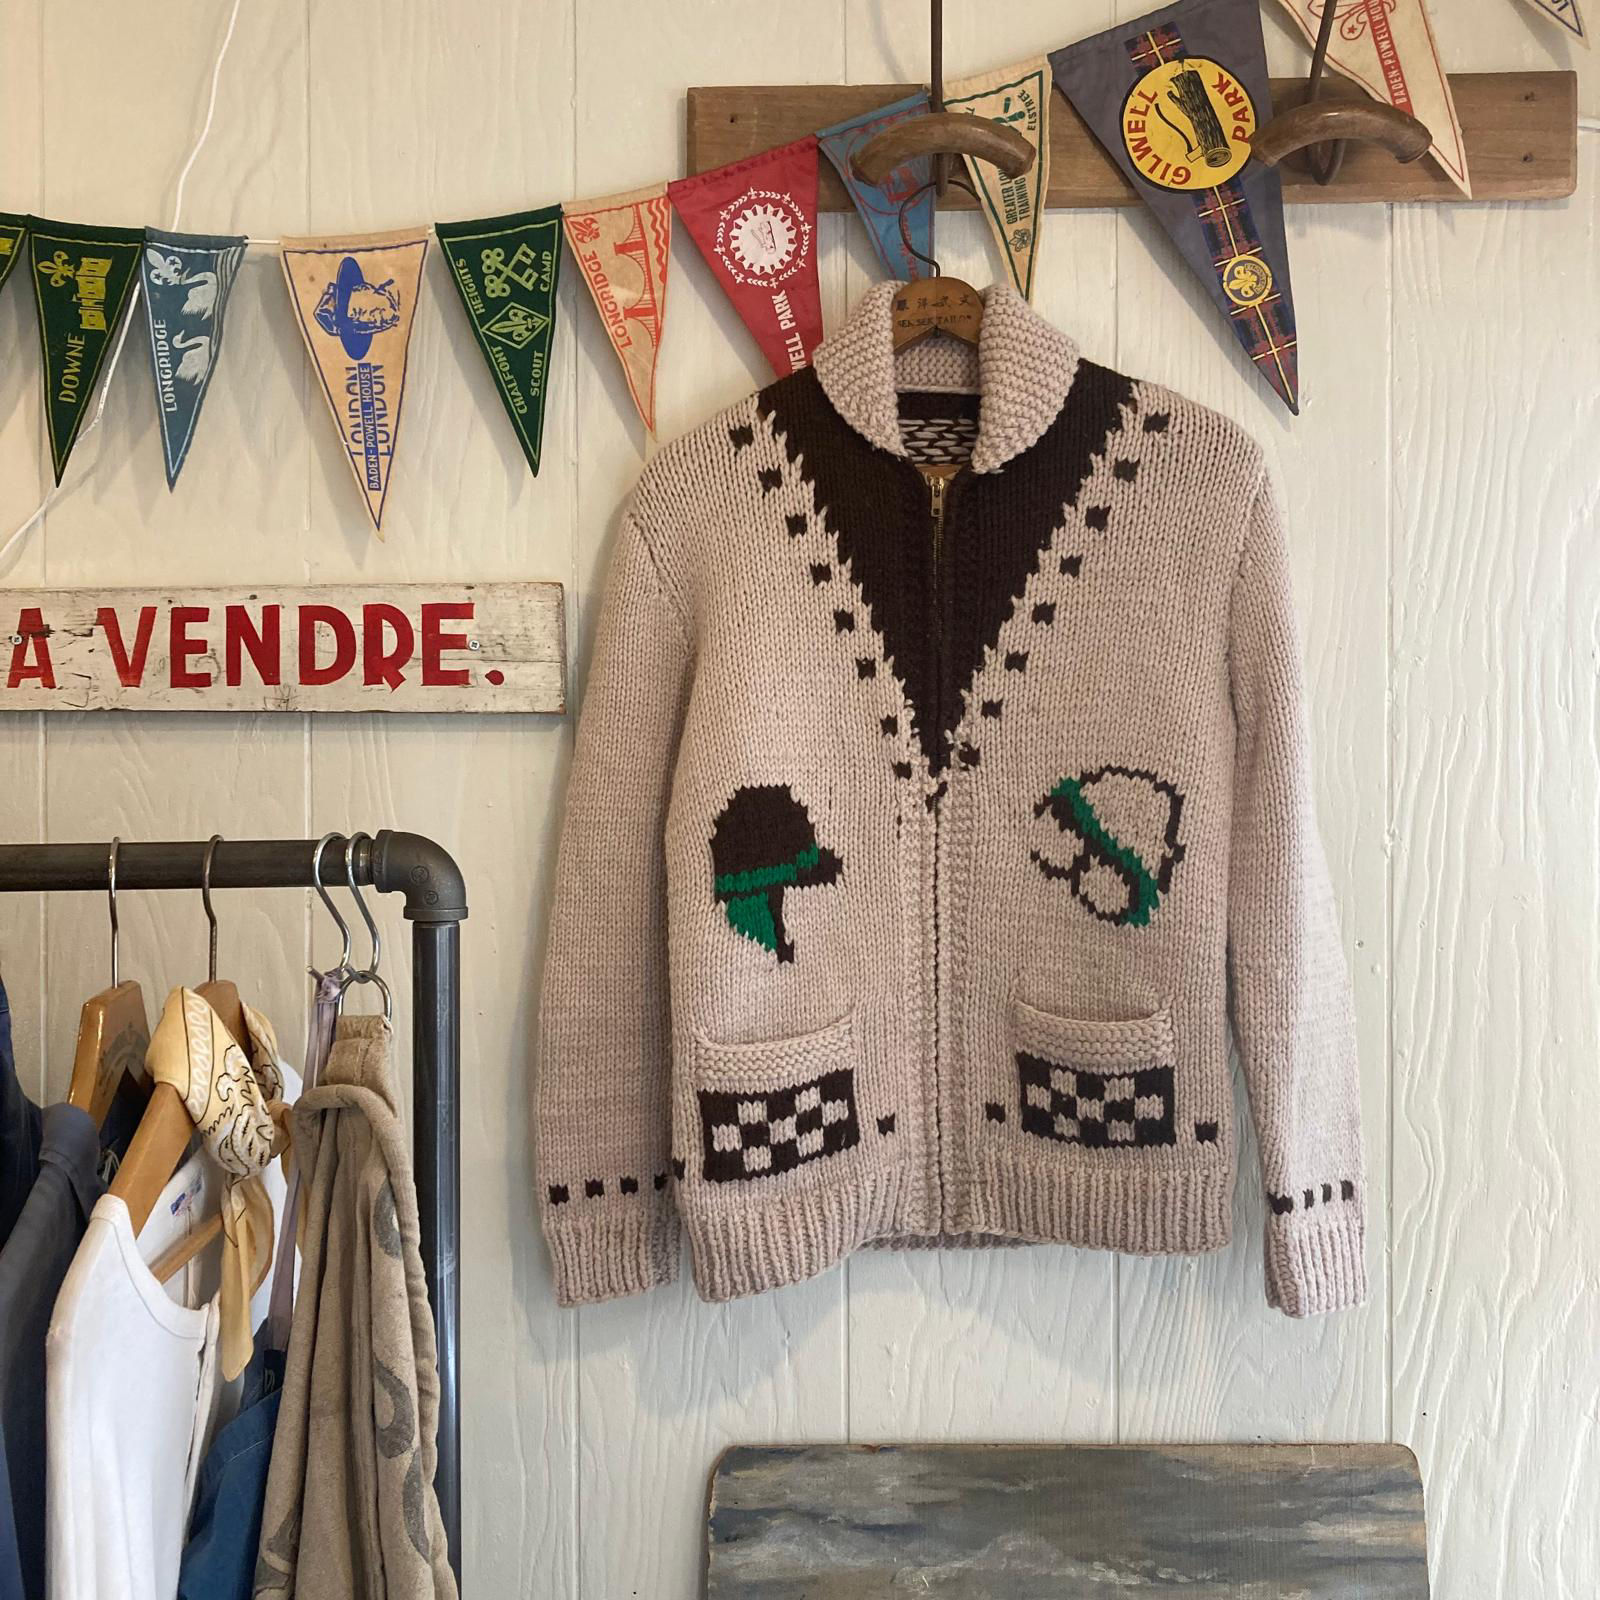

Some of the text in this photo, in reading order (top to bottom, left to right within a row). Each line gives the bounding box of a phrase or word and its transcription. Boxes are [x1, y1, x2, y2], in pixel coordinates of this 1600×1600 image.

[1374, 22, 1408, 105] BADEN-POWELL
[1017, 89, 1038, 131] ELSTREE
[1126, 71, 1251, 186] GILWELL PARK
[1001, 186, 1019, 225] GREATER
[1014, 176, 1031, 221] TRAINING
[455, 258, 527, 414] CHALFONT HEIGHTS
[530, 250, 551, 397] SCOUT CAMP
[582, 250, 633, 349] LONGRIDGE
[771, 289, 796, 330] PARK
[58, 332, 85, 403] DOWNE
[153, 319, 178, 412] LONGRIDGE
[360, 367, 373, 402] HOUSE
[6, 602, 505, 693] A VENDRE.
